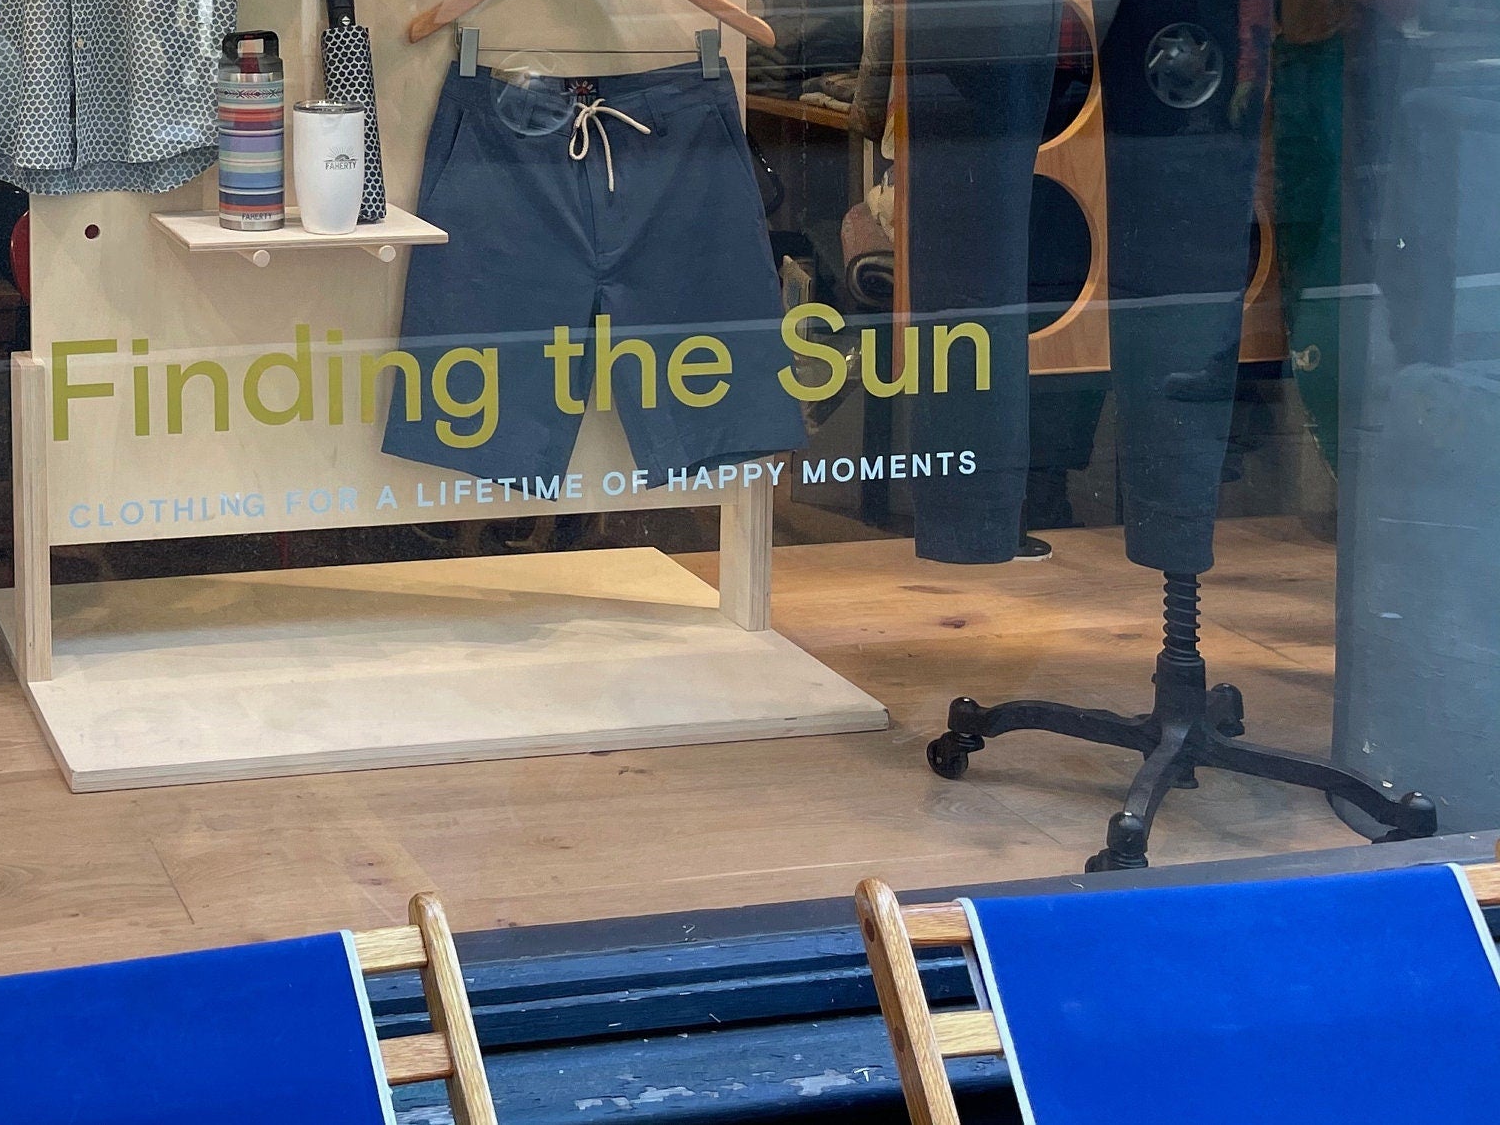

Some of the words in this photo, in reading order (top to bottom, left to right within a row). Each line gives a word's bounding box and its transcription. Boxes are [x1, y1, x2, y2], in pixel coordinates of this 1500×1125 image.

[325, 160, 357, 171] FAHERTY
[241, 212, 273, 221] FAHERTY
[50, 323, 499, 449] Finding
[544, 314, 732, 413] the
[778, 302, 992, 402] Sun
[69, 492, 266, 529] CLOTHING
[285, 486, 357, 515] FOR
[376, 485, 398, 510] A
[417, 474, 583, 508] LIFETIME
[603, 468, 649, 496] OF
[668, 461, 785, 493] HAPPY
[802, 450, 977, 484] MOMENTS
